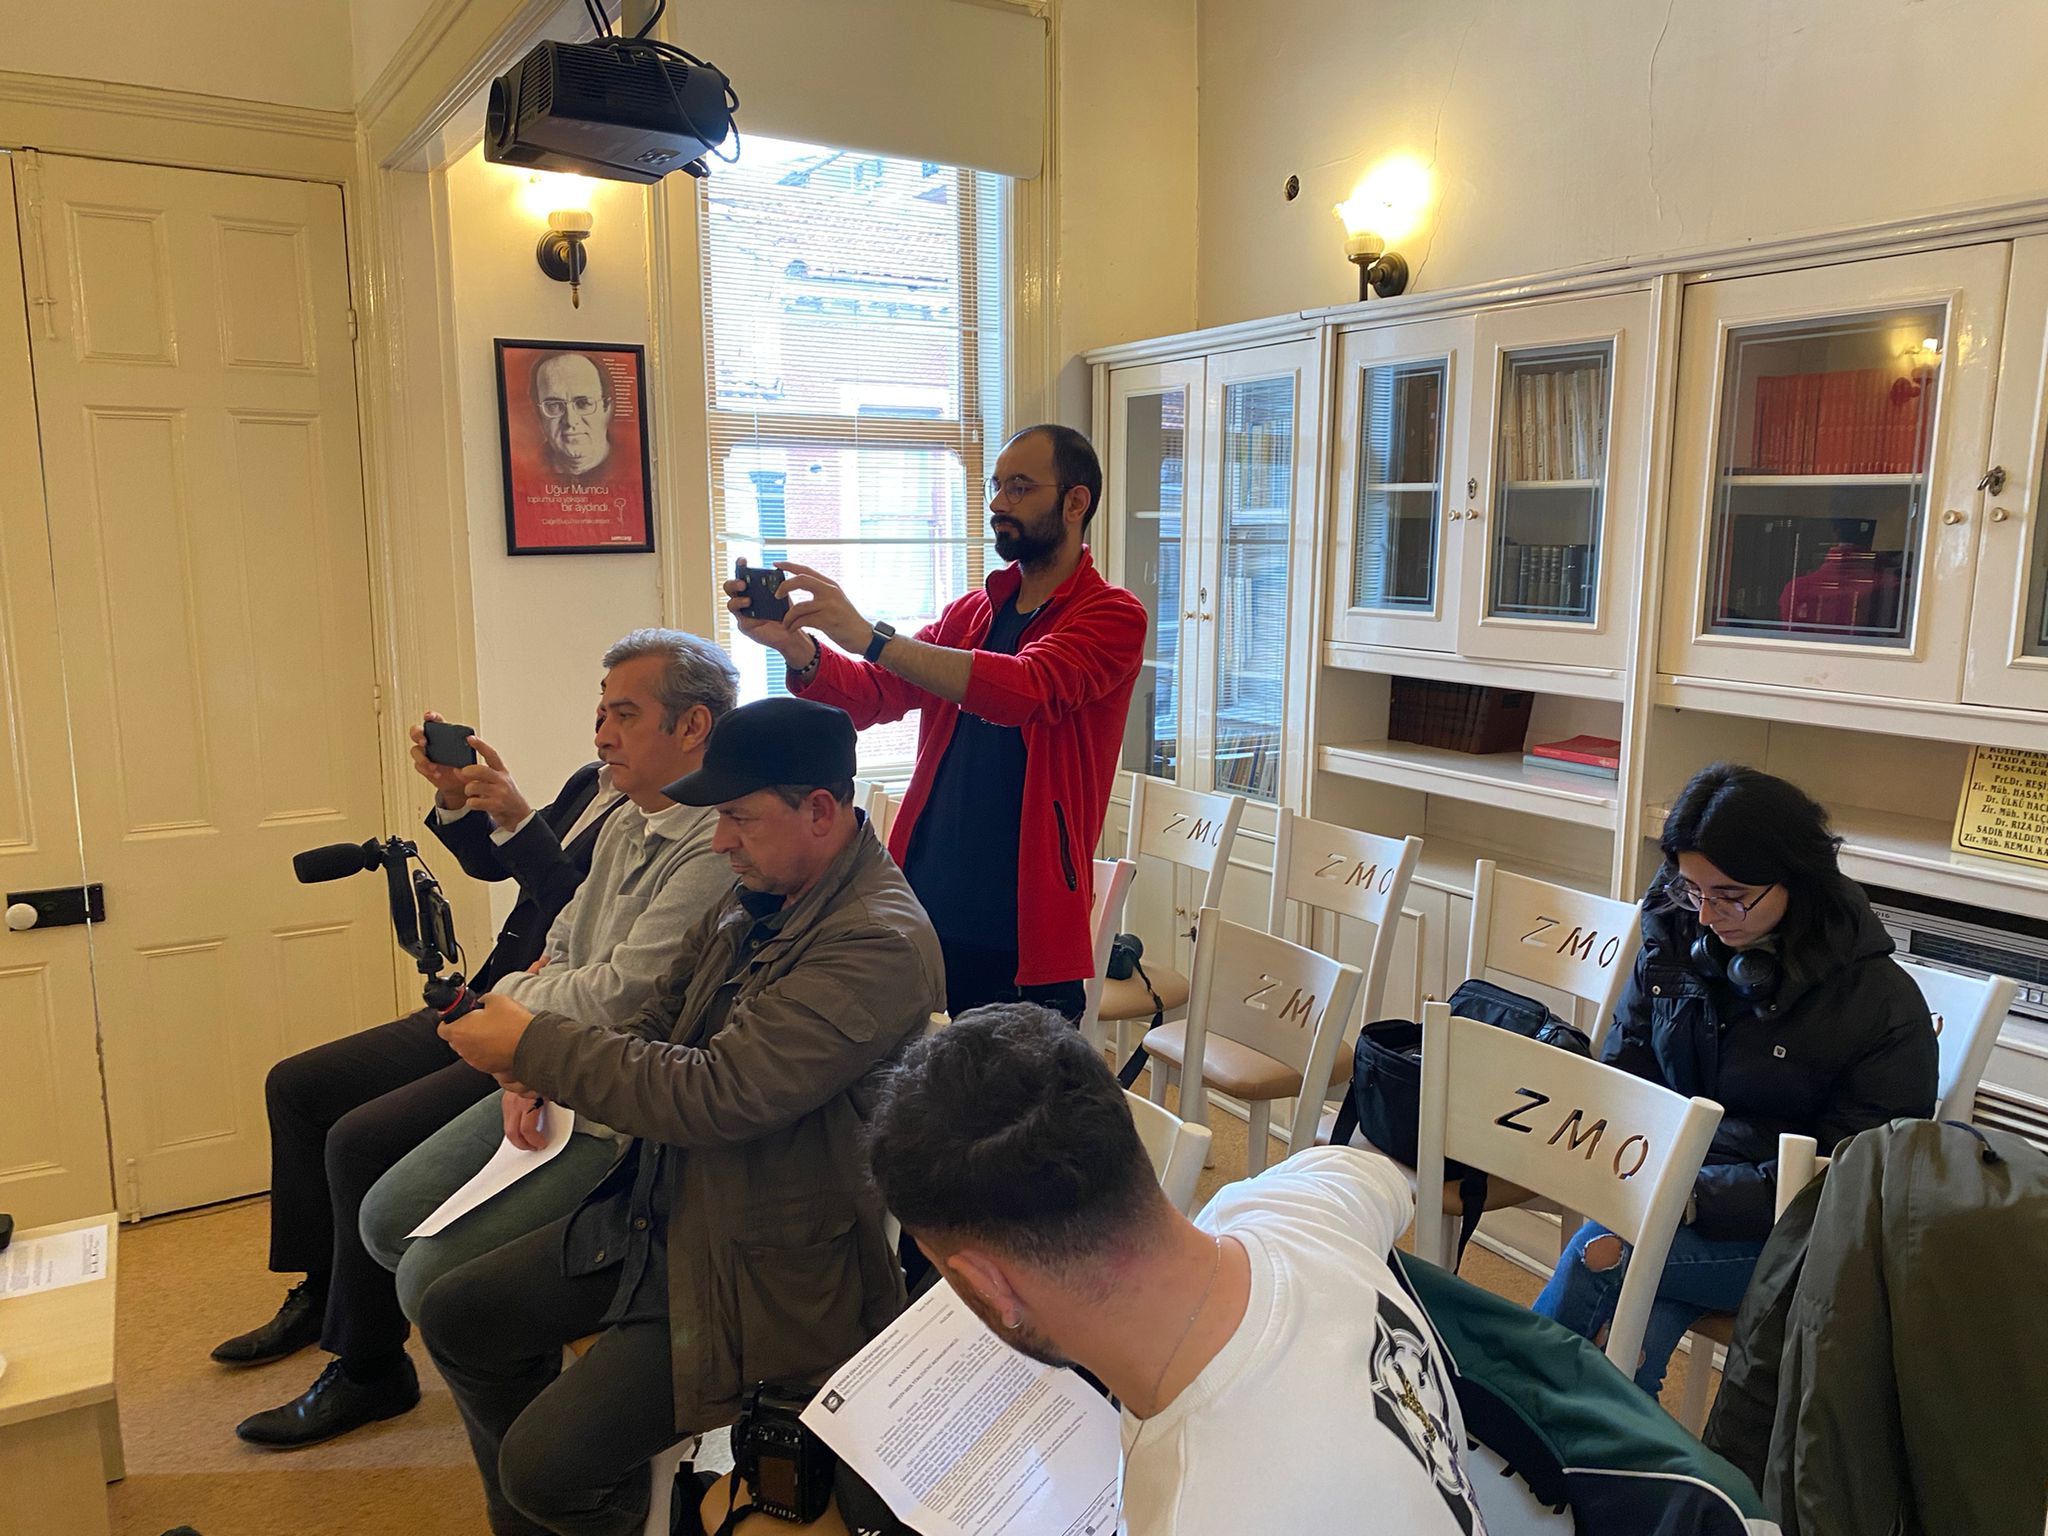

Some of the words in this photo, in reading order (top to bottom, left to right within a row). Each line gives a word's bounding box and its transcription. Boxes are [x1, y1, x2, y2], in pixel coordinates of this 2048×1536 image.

[545, 484, 569, 496] Uğur
[571, 484, 609, 495] Mumcu
[1979, 753, 2027, 766] KATKIDA
[1972, 782, 1988, 792] Zir.
[1991, 784, 2011, 795] Müh.
[2013, 788, 2044, 801] HASAN
[1981, 804, 1997, 815] Zir.
[2000, 807, 2020, 818] Müh.
[1986, 794, 1999, 805] Dr.
[2001, 795, 2025, 809] ÜLKÜ
[1995, 817, 2008, 827] Dr.
[2011, 820, 2032, 832] RIZA
[1964, 833, 1979, 843] Zir.
[1981, 836, 2002, 848] Müh.
[2004, 840, 2034, 854] KEMAL
[1976, 824, 2003, 837] SADIK
[2005, 830, 2042, 845] HALDUN
[1314, 852, 1395, 896] ZMO
[1520, 915, 1620, 969] ZMO
[1494, 1086, 1650, 1181] ZMO
